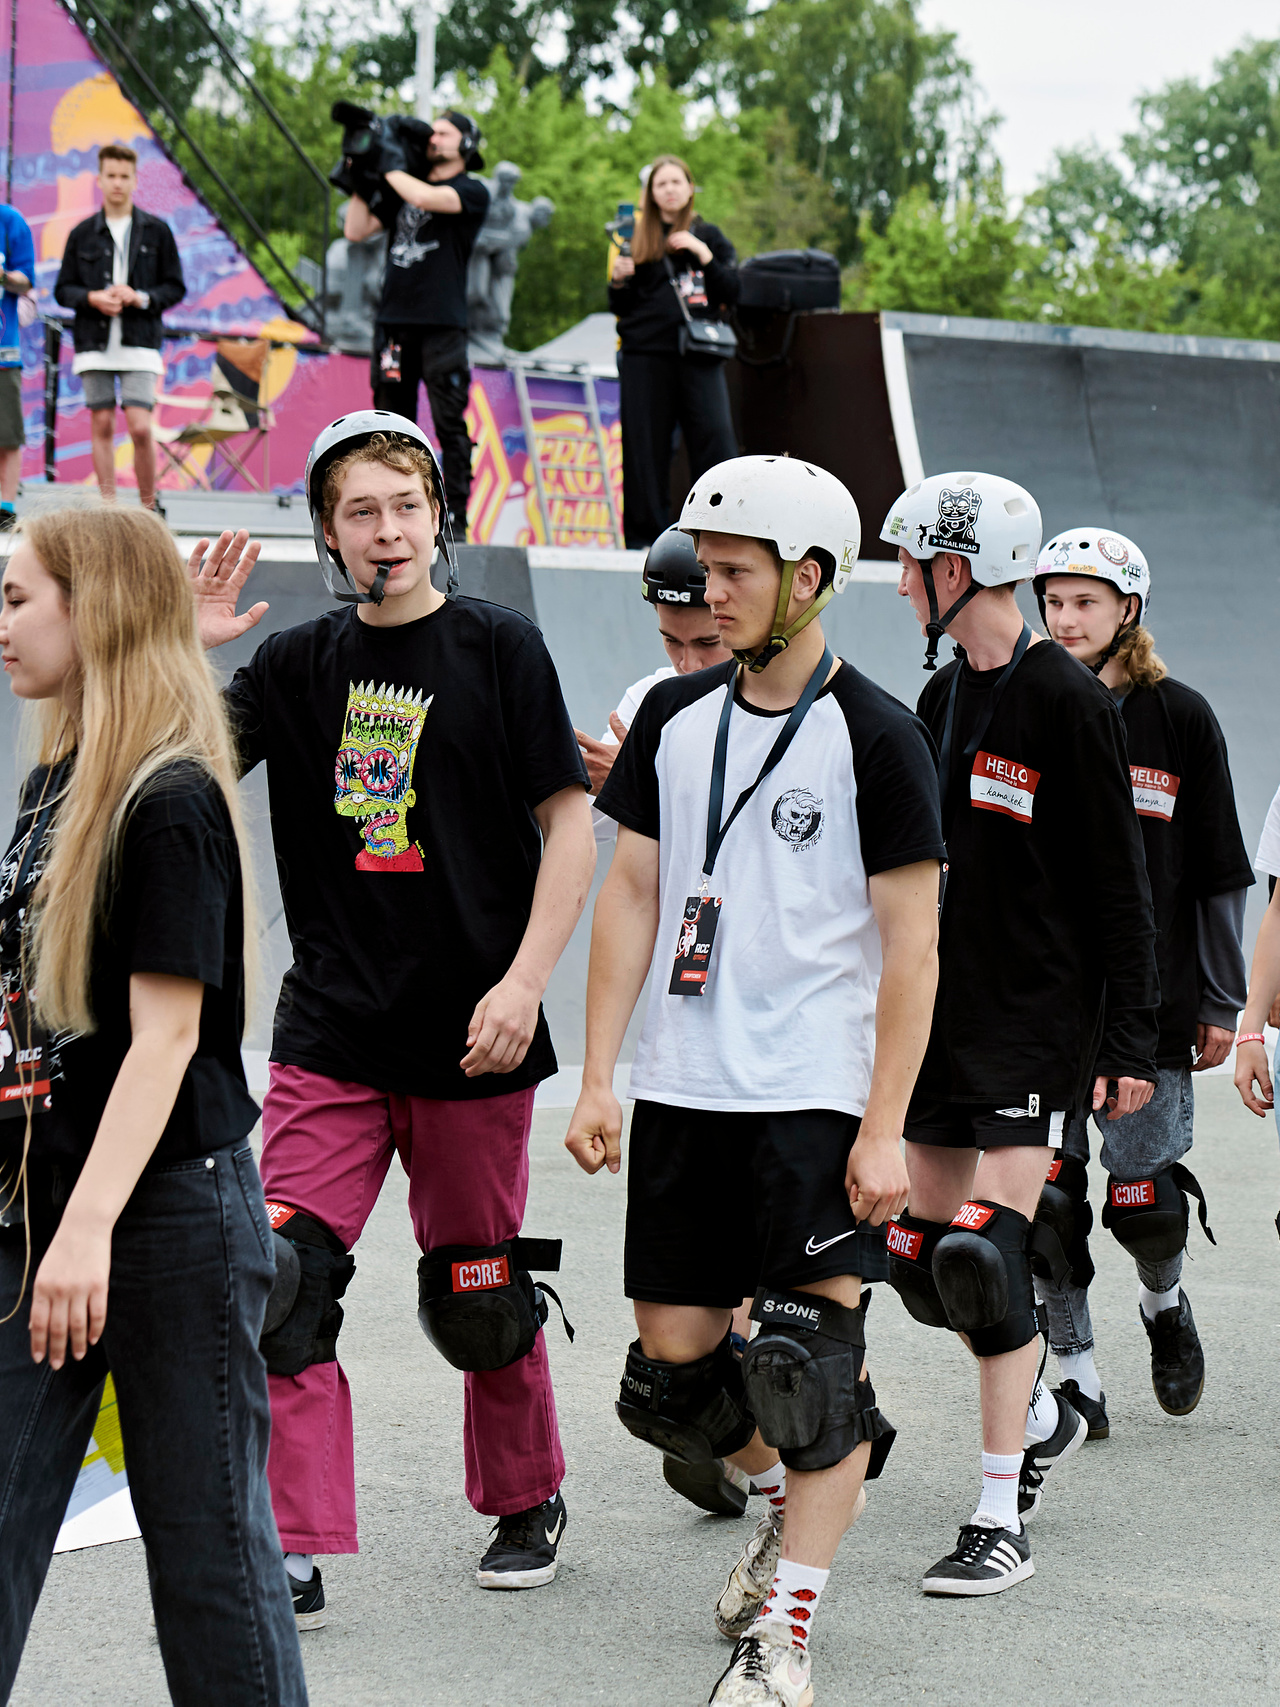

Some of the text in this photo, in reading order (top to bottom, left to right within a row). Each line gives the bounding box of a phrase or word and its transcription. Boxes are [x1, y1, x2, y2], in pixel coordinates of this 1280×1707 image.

[938, 538, 978, 552] TRAILHEAD
[985, 756, 1028, 783] HELLO
[1130, 768, 1170, 787] HELLO
[694, 943, 711, 954] RCC
[1115, 1184, 1149, 1204] CORE
[264, 1203, 288, 1224] RE
[951, 1204, 986, 1226] ORE
[886, 1226, 916, 1255] CORE
[459, 1261, 503, 1288] CORE
